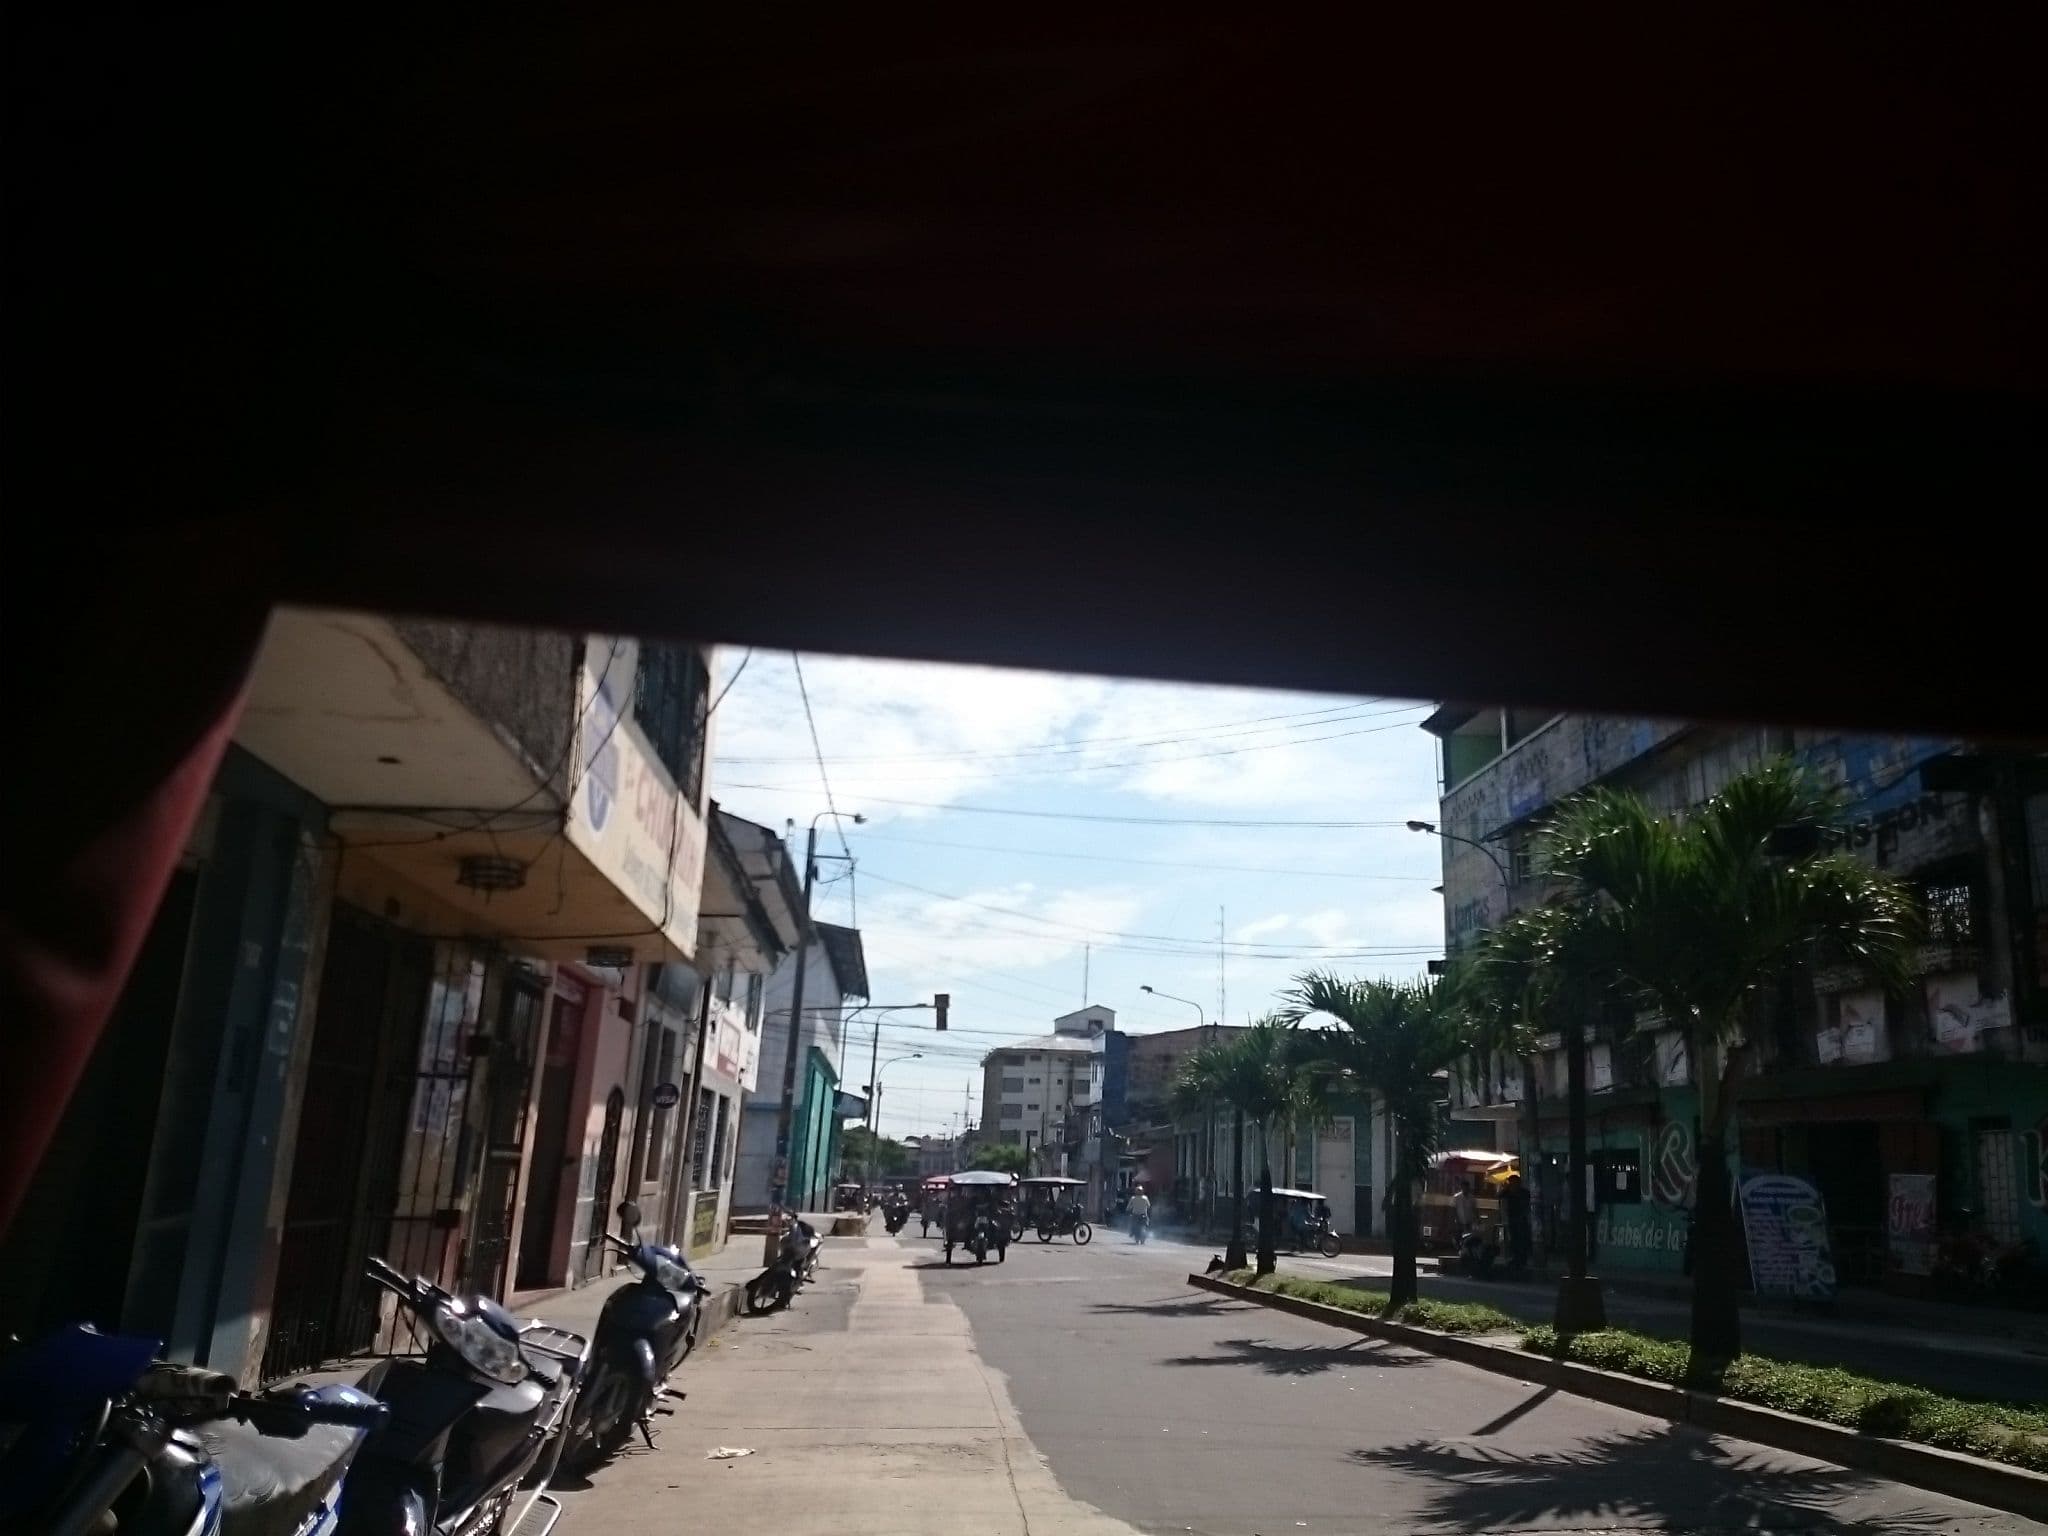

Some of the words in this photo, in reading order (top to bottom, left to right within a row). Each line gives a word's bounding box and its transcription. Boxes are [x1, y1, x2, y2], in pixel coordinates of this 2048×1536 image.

[1596, 1217, 1609, 1246] El
[1646, 1218, 1663, 1249] de
[1667, 1220, 1681, 1252] la
